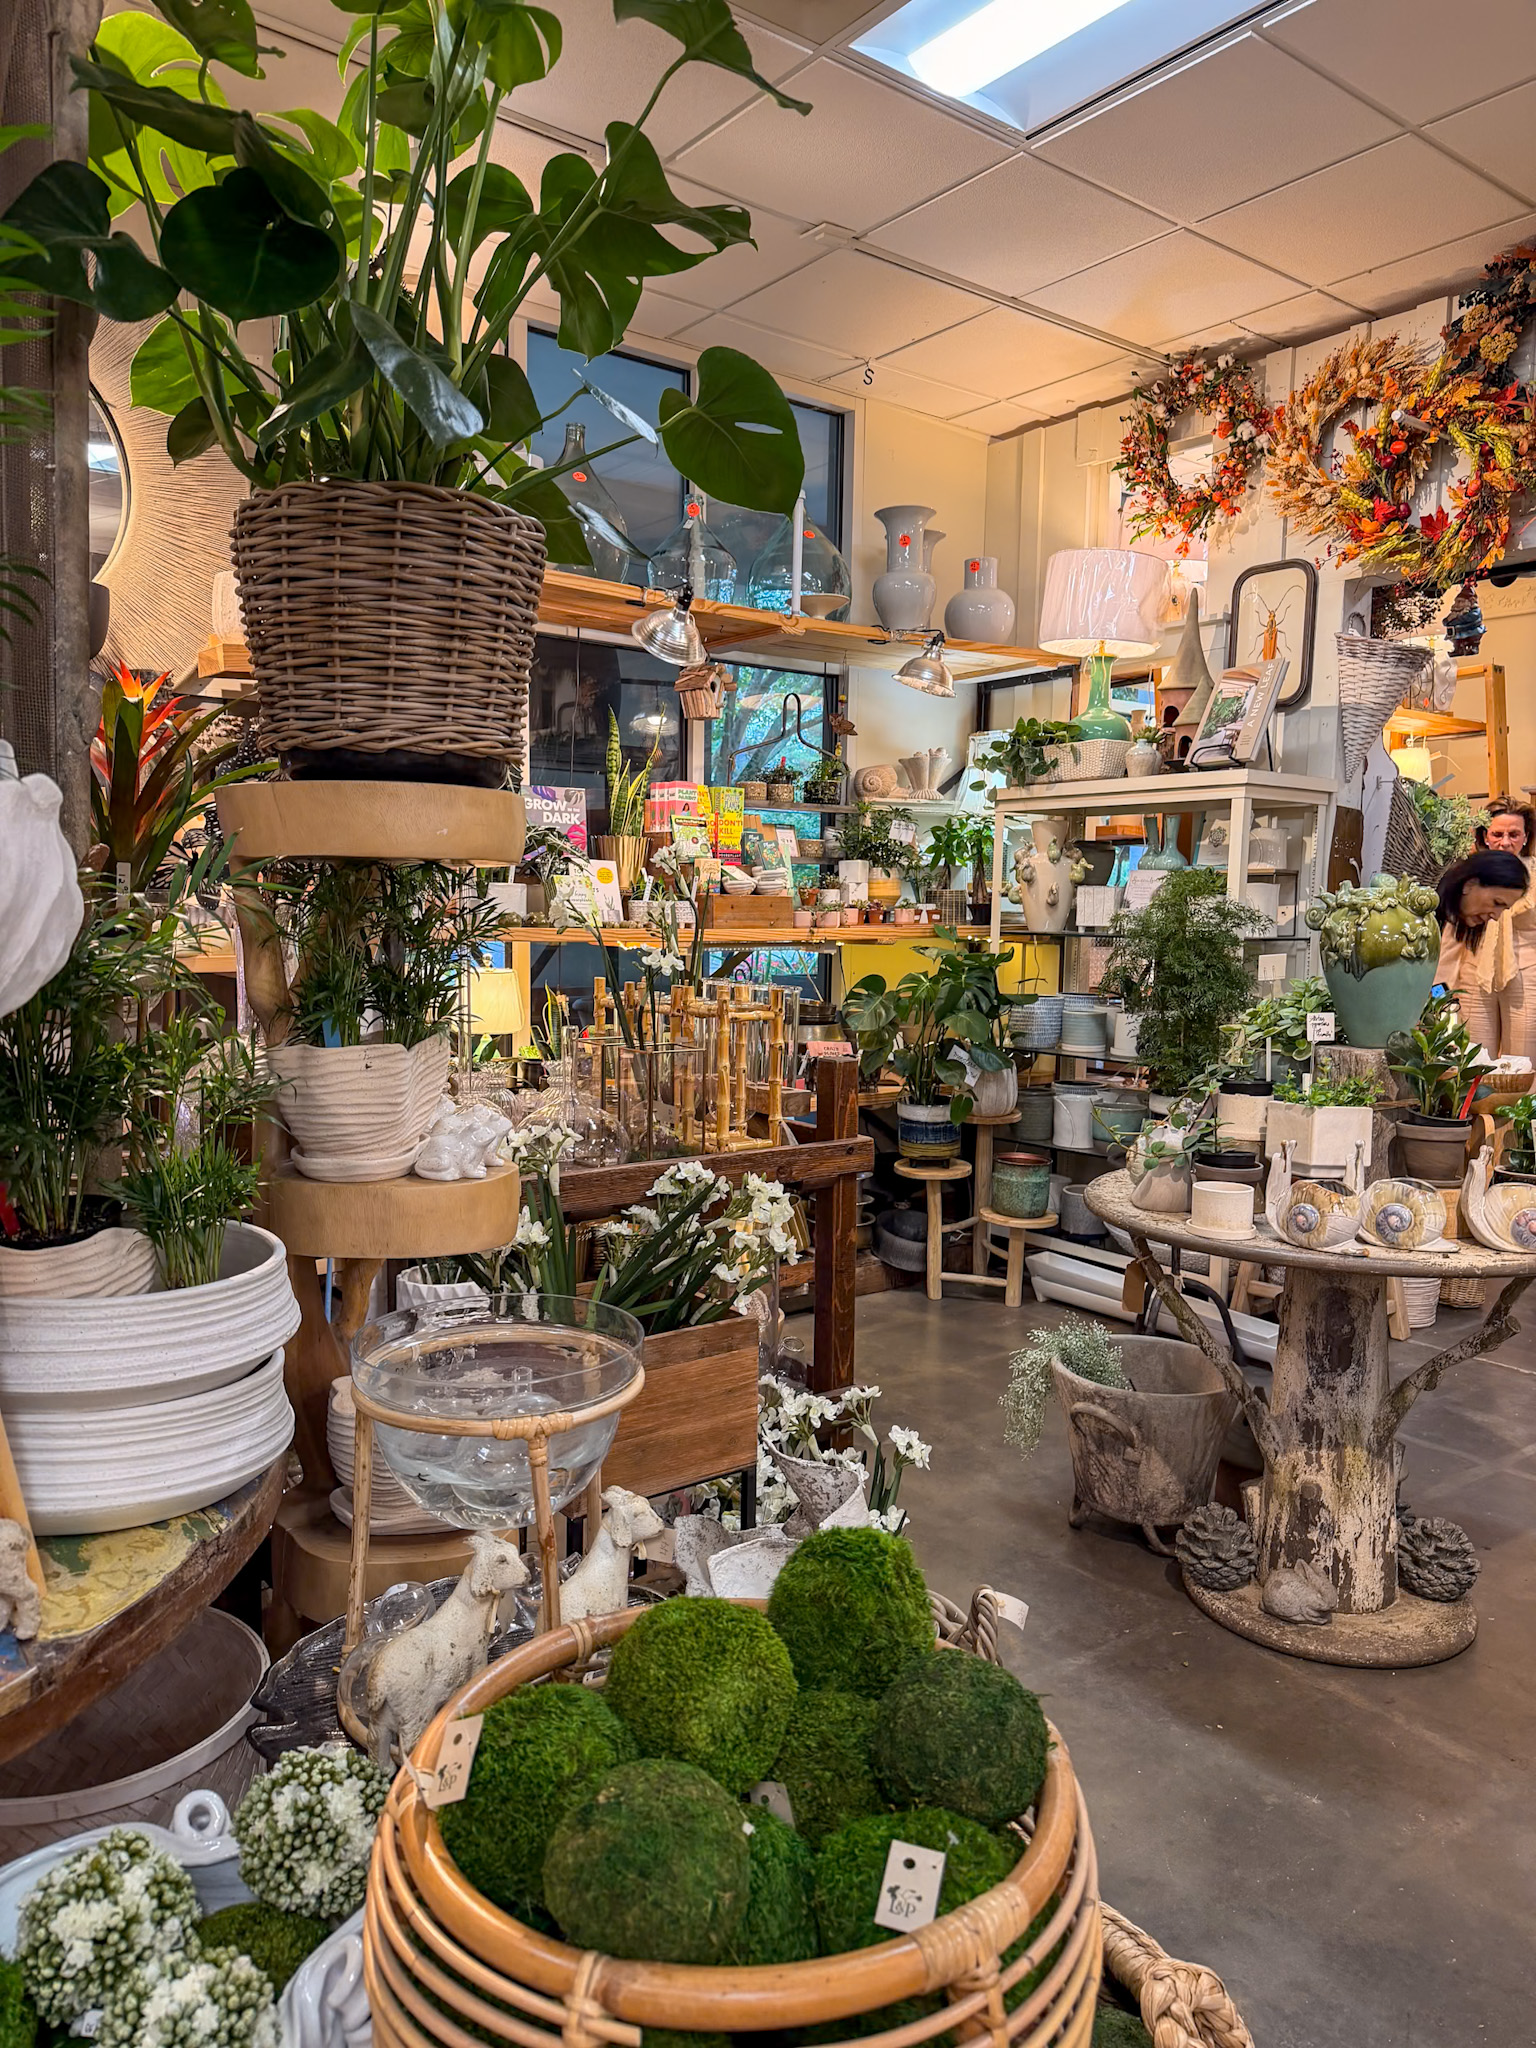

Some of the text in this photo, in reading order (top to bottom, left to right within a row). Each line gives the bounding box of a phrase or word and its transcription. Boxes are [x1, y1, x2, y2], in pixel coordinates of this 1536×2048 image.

[1250, 692, 1265, 717] NEW
[1261, 662, 1275, 689] LEAF
[524, 798, 567, 812] GROW
[543, 812, 581, 825] DARK
